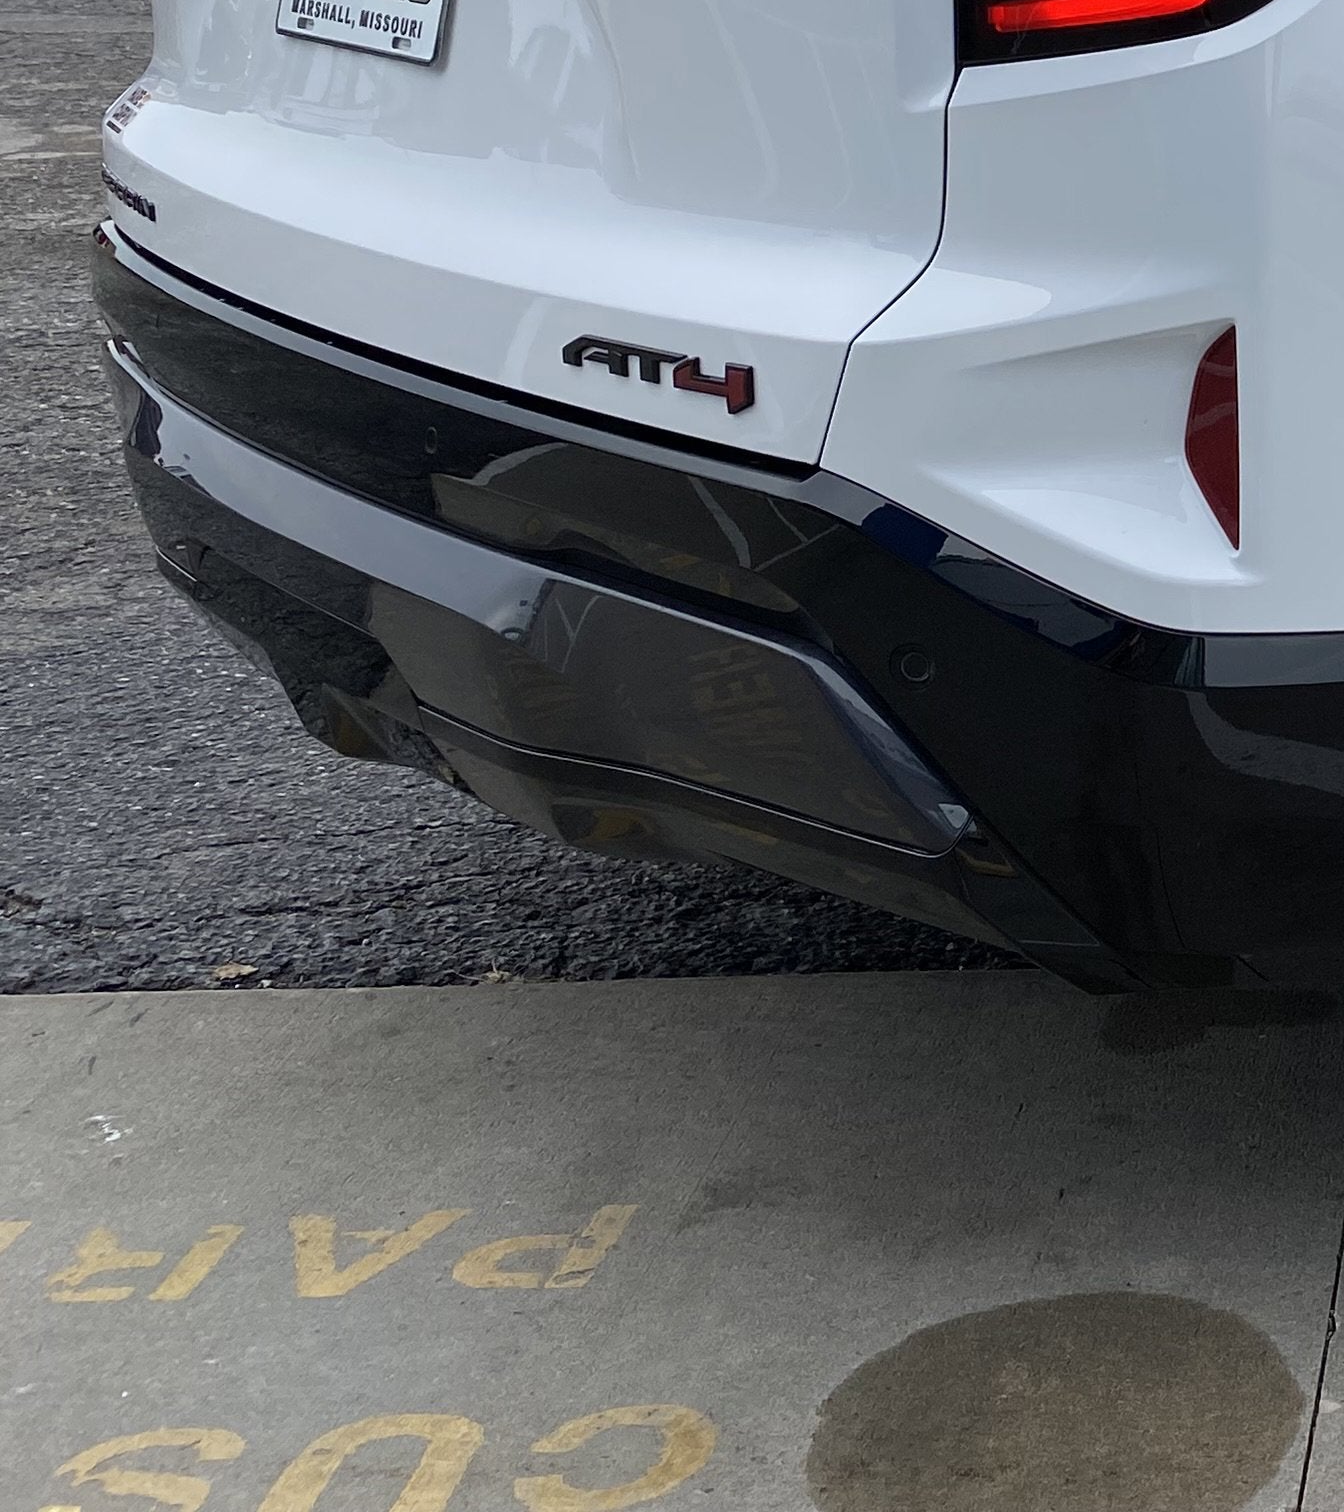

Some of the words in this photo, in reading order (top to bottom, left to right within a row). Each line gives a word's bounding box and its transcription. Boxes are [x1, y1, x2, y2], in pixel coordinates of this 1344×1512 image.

[359, 9, 424, 39] MISSOURI
[561, 333, 755, 415] AT4
[0, 1203, 641, 1302] PAR
[38, 1402, 718, 1512] CUS
